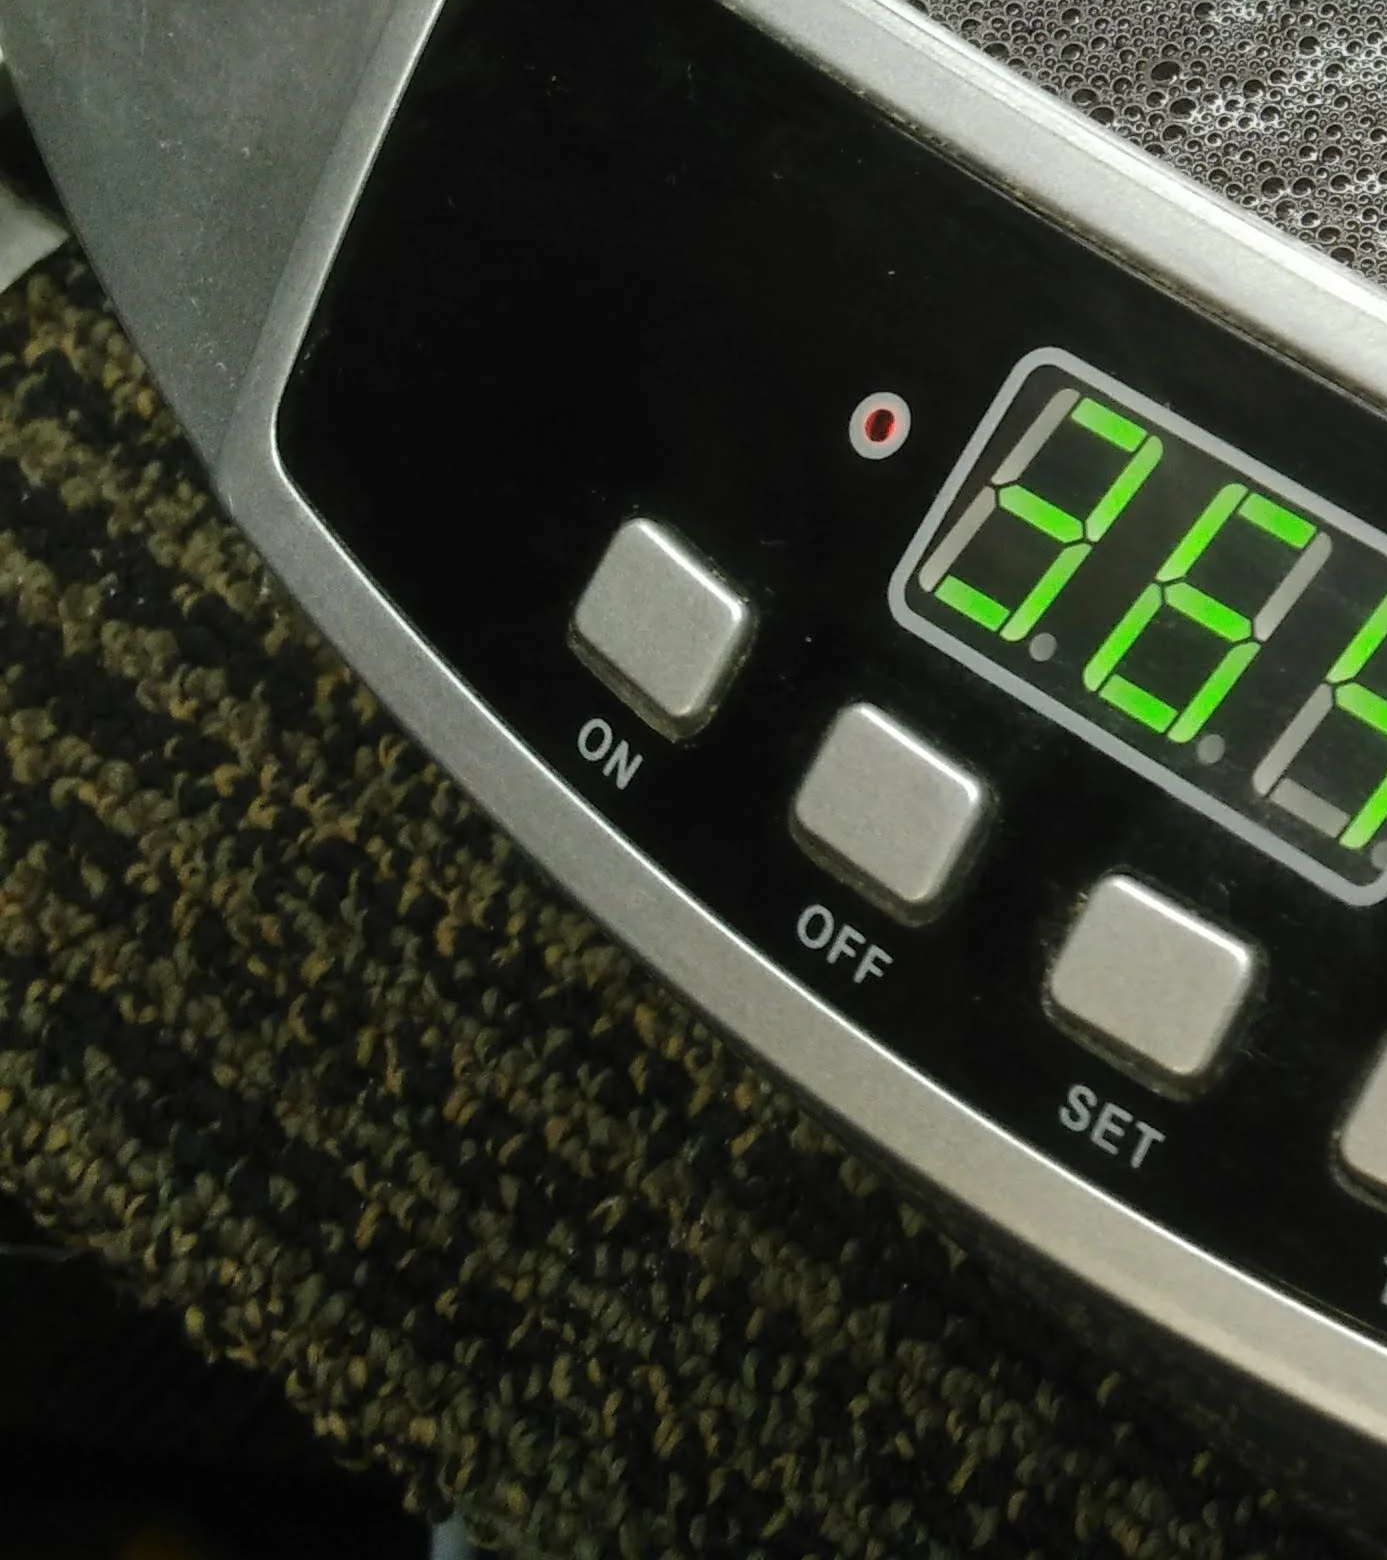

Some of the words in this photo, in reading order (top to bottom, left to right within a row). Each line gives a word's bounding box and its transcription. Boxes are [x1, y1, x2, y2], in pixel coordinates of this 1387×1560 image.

[577, 718, 643, 790] ON
[796, 904, 894, 986] OFF
[1059, 1085, 1166, 1169] SET
